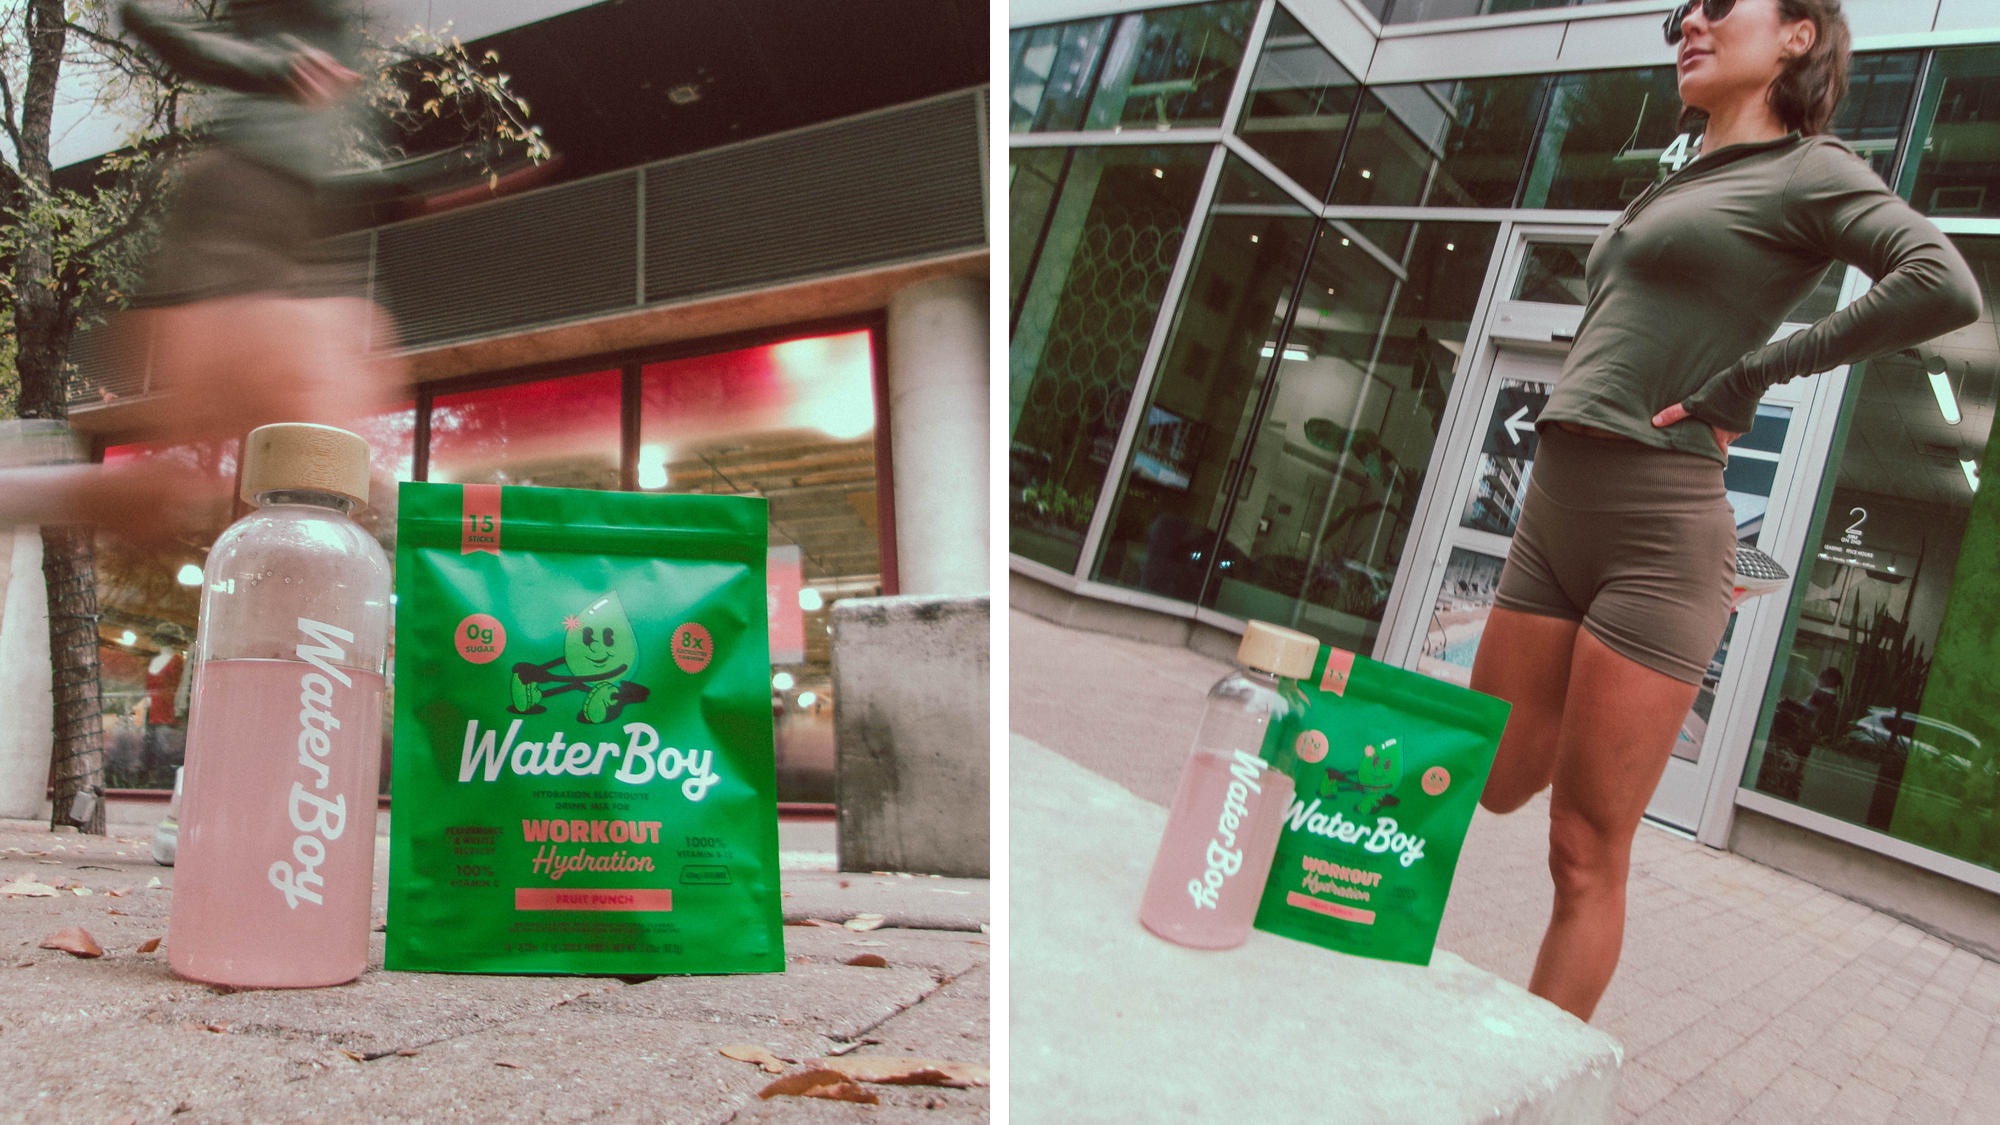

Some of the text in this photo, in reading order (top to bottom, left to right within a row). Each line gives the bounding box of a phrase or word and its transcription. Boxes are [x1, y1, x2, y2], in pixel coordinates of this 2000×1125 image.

[469, 514, 494, 533] 15
[1845, 507, 1867, 535] 2
[681, 631, 703, 649] 8x
[268, 617, 354, 909] WaterBoy
[458, 719, 721, 802] WaterBoy
[532, 790, 649, 801] HYDRATION ELECTROLYTE
[555, 802, 630, 811] DRINK MIX FOR
[522, 819, 662, 844] WORKOUT
[1188, 748, 1268, 910] WaterBoy
[685, 836, 726, 848] 1000%
[532, 845, 656, 880] Hydration
[676, 850, 713, 858] VITAMIN
[456, 865, 495, 877] 100%
[1302, 855, 1382, 887] WORKOUT
[449, 879, 501, 887] VITAMIN C
[556, 894, 634, 905] FRUIT PUNCH
